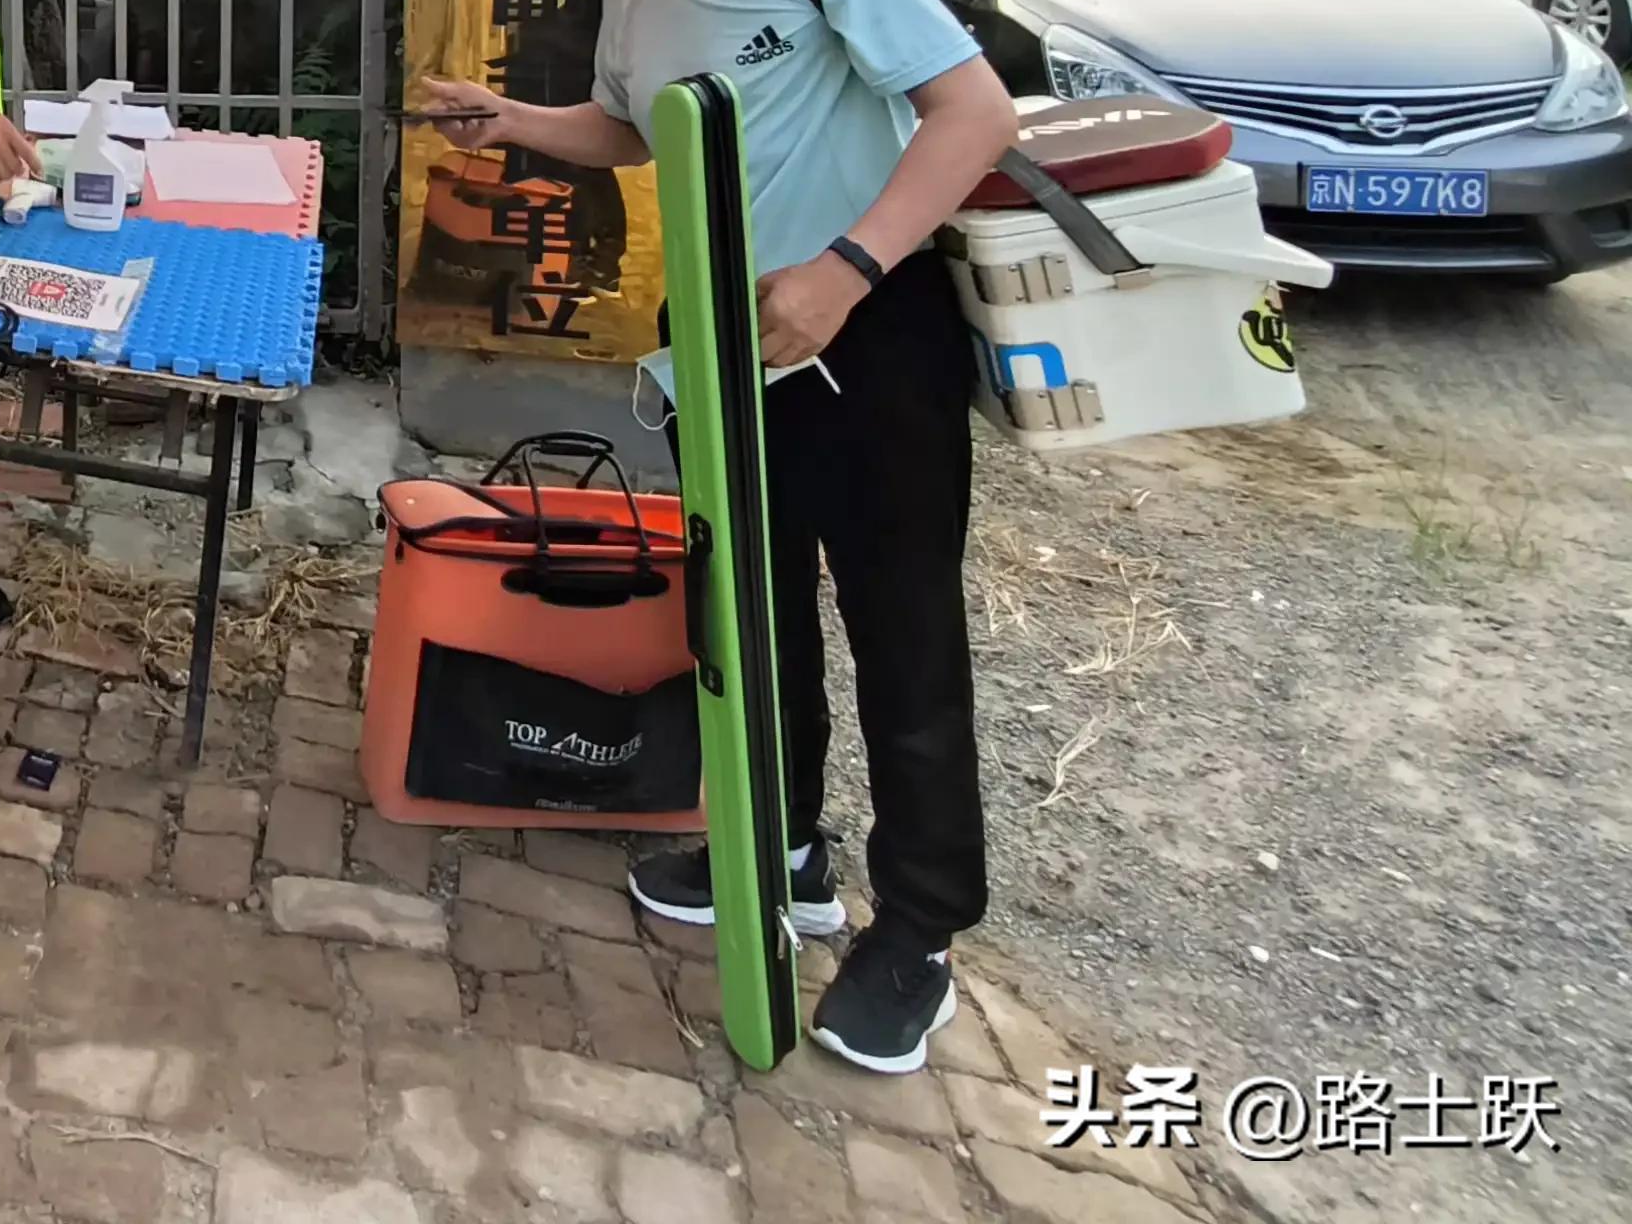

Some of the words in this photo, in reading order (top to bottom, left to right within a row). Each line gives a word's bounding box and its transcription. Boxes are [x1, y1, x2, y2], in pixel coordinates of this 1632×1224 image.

[735, 38, 795, 67] adidas
[504, 719, 547, 745] TOP
[550, 731, 644, 762] ATHLETE
